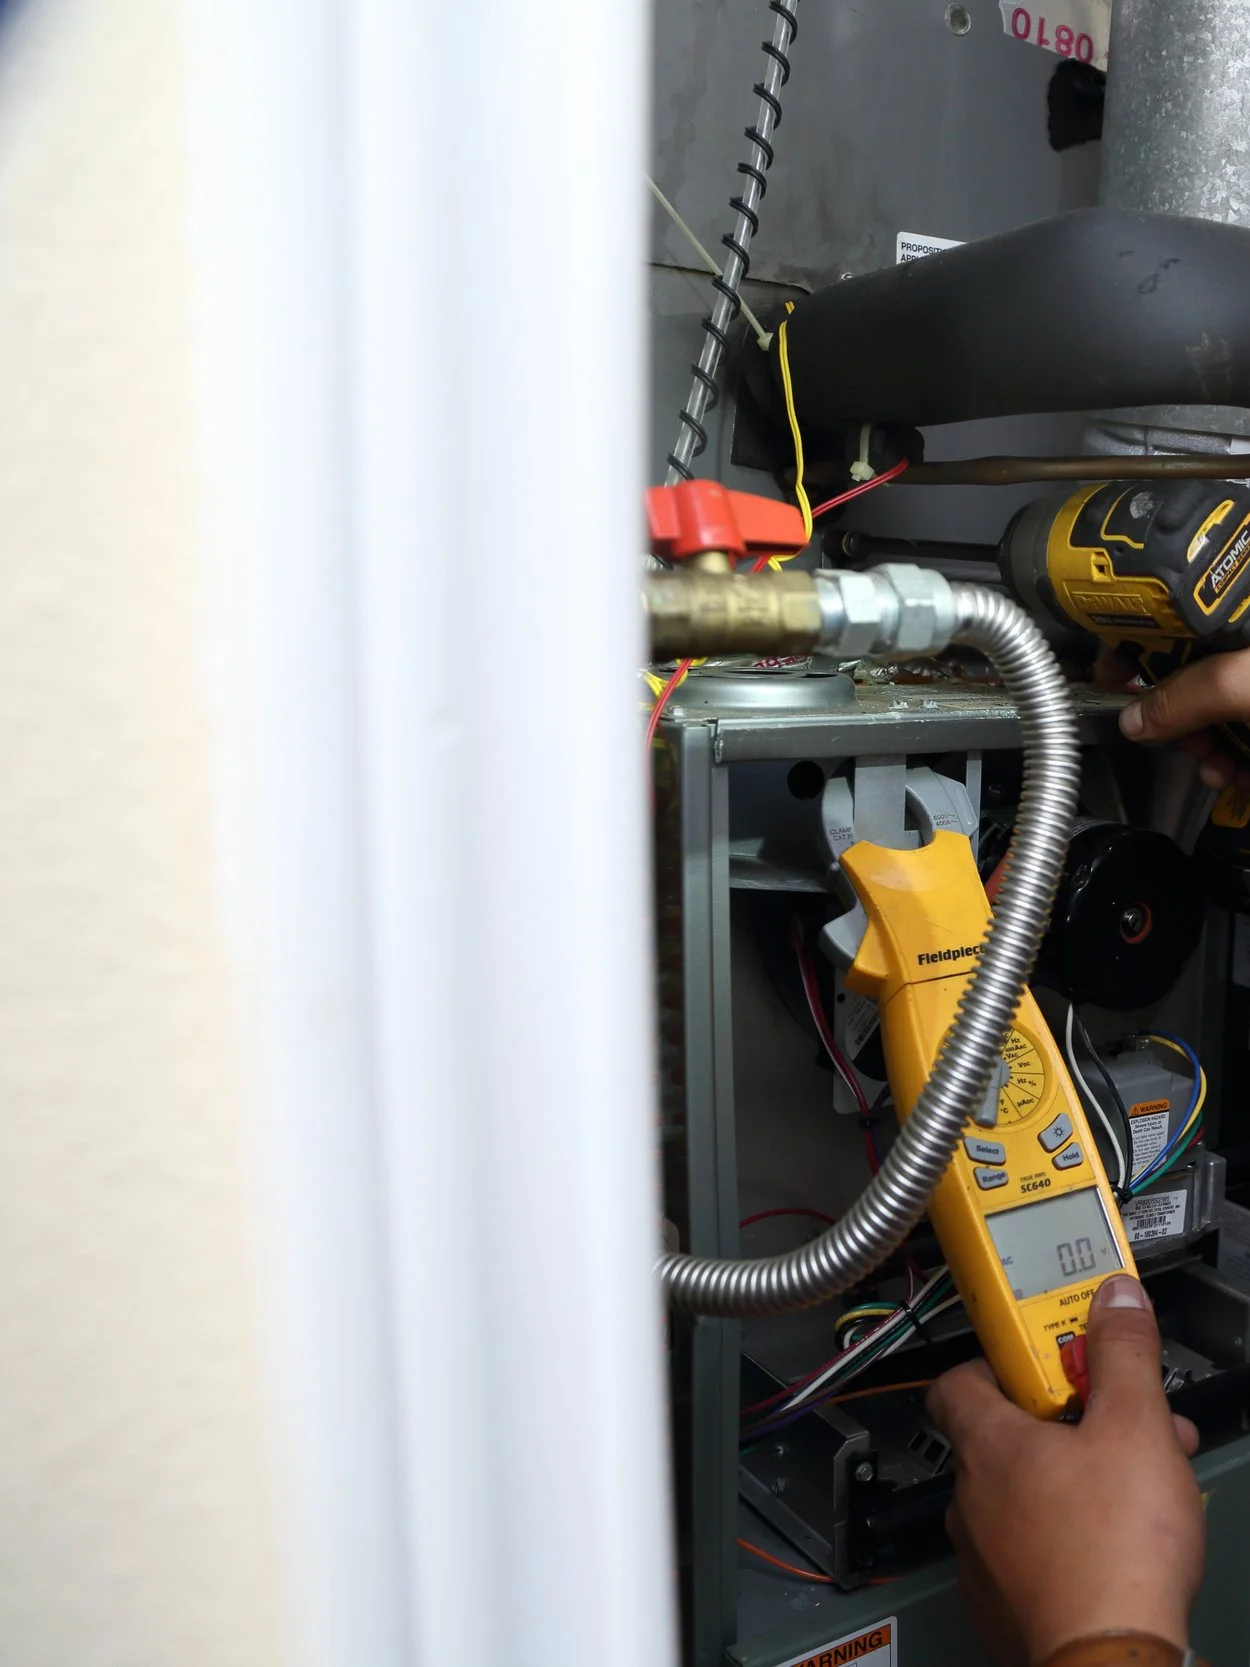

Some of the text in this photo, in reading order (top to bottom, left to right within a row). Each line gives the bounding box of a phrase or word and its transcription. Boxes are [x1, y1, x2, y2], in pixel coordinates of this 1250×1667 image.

[1012, 7, 1093, 63] 0810
[1210, 530, 1250, 588] ATOMIC
[829, 827, 852, 835] CLAMP
[1140, 1102, 1168, 1112] WARNING
[976, 1145, 999, 1155] Select
[1063, 1152, 1080, 1161] Hold
[982, 1172, 1006, 1183] Range
[1020, 1178, 1051, 1194] SC640
[1056, 1237, 1096, 1277] 0.0
[1060, 1294, 1080, 1307] AUTO
[1043, 1322, 1060, 1332] TYPE
[1057, 1333, 1074, 1344] COM
[799, 1631, 883, 1667] ARNING
